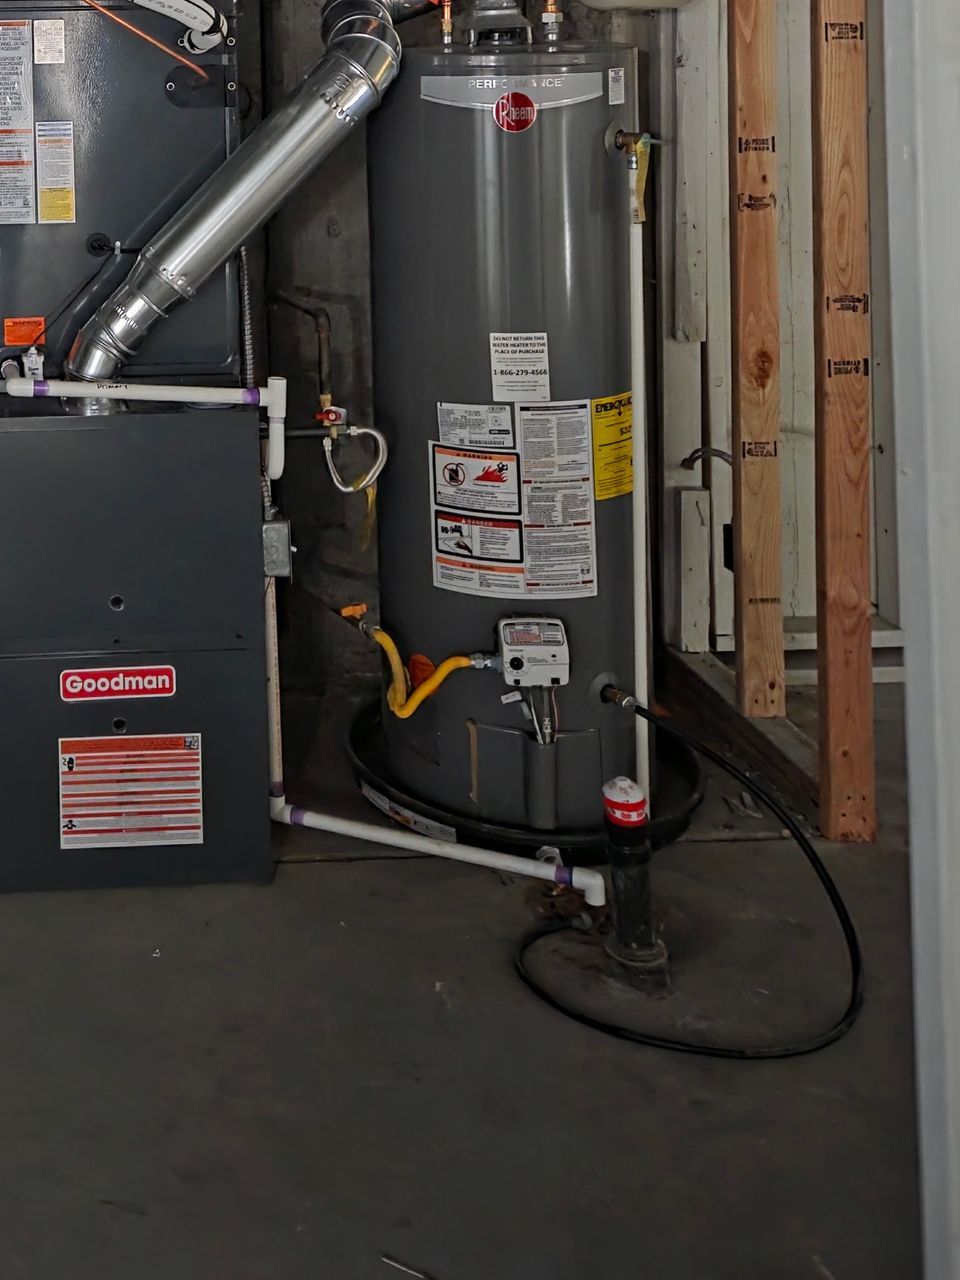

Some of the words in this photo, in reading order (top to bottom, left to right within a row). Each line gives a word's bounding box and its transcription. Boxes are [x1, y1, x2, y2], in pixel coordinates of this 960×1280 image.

[468, 79, 563, 89] PERFOMANCE
[498, 92, 534, 125] Rheem
[65, 673, 170, 693] Goodman
